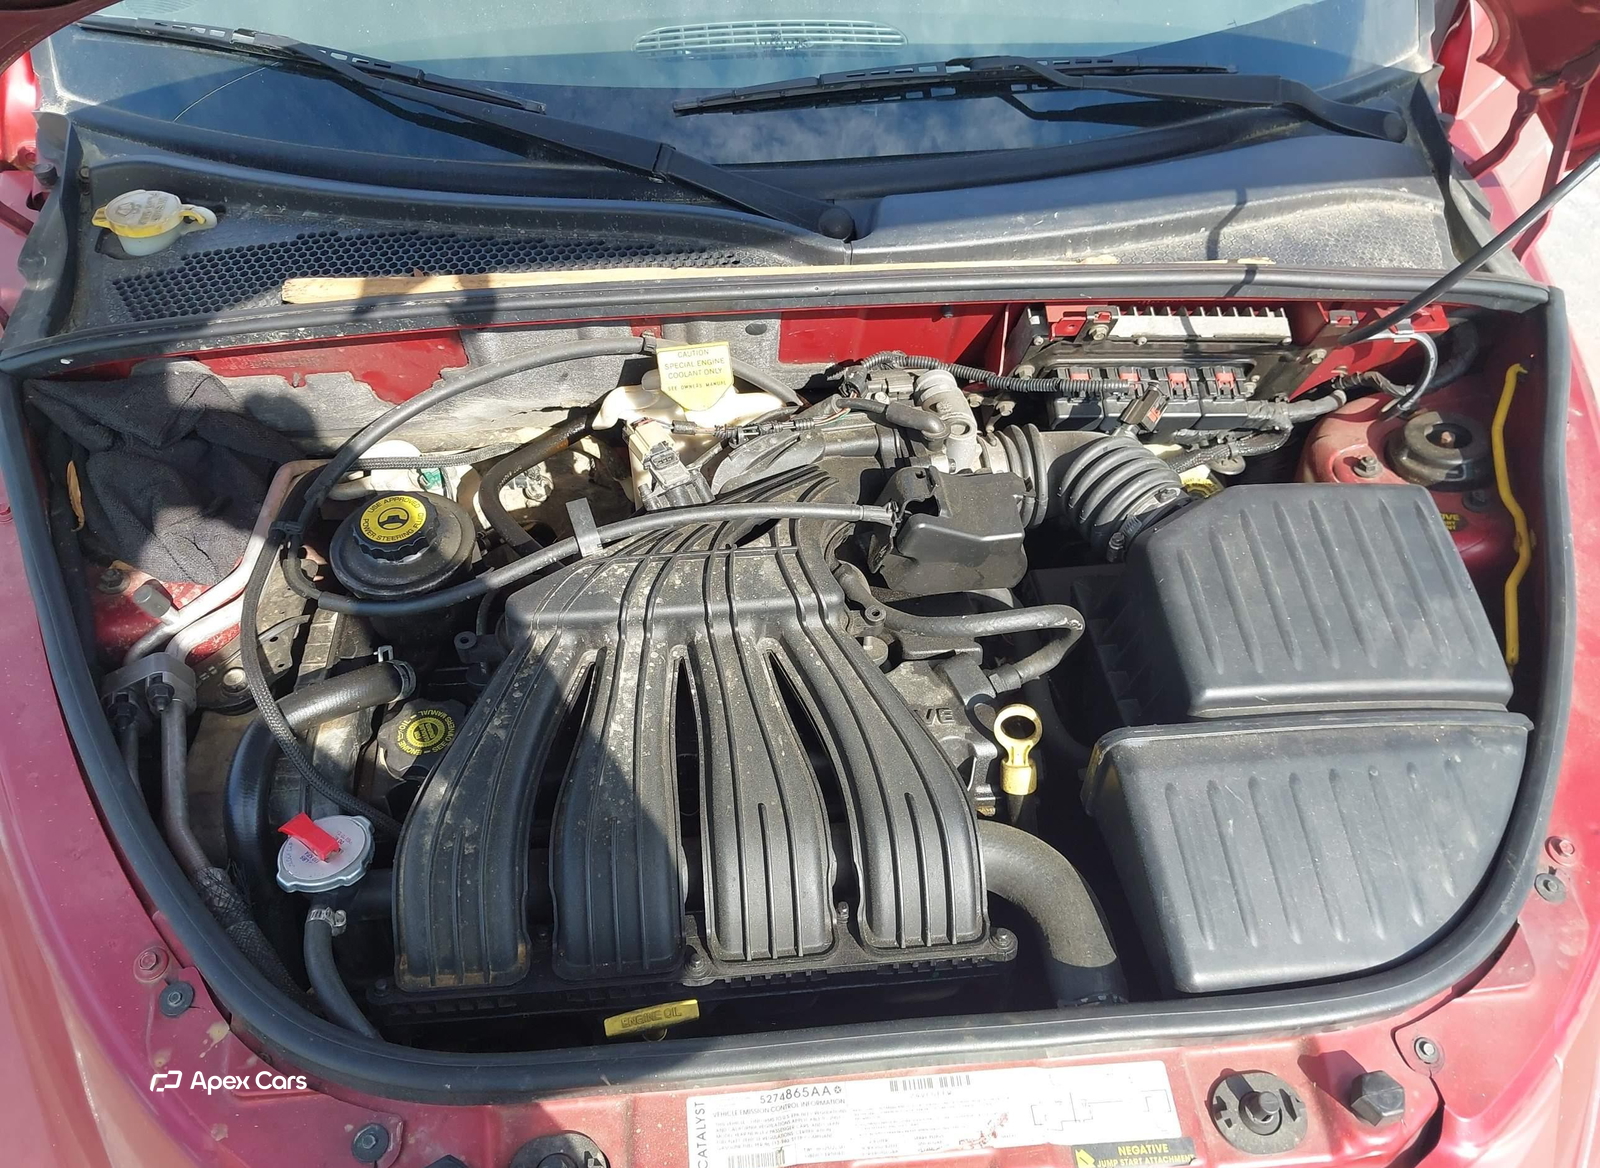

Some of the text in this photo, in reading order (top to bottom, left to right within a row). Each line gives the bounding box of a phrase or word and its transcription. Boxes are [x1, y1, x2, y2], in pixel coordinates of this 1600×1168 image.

[677, 349, 709, 358] CAUTION
[664, 357, 725, 370] SPECIAL ENGINE
[668, 367, 722, 379] COOLANT ONLY
[369, 497, 420, 513] USE APPROVED
[363, 513, 424, 541] POWER STEERING FLUID
[418, 709, 448, 719] MANUAL
[399, 720, 411, 730] OIL
[432, 742, 447, 753] SEE
[621, 1006, 682, 1028] ENGINE OIL
[760, 1085, 832, 1104] 5274865AA
[713, 1098, 846, 1118] VEHICLE EMISSION CONTROL INFORMATION
[694, 1101, 708, 1168] CATALYST
[1117, 1144, 1168, 1156] NEGATIVE
[1097, 1154, 1195, 1168] JUMP START ATTACHMENT
